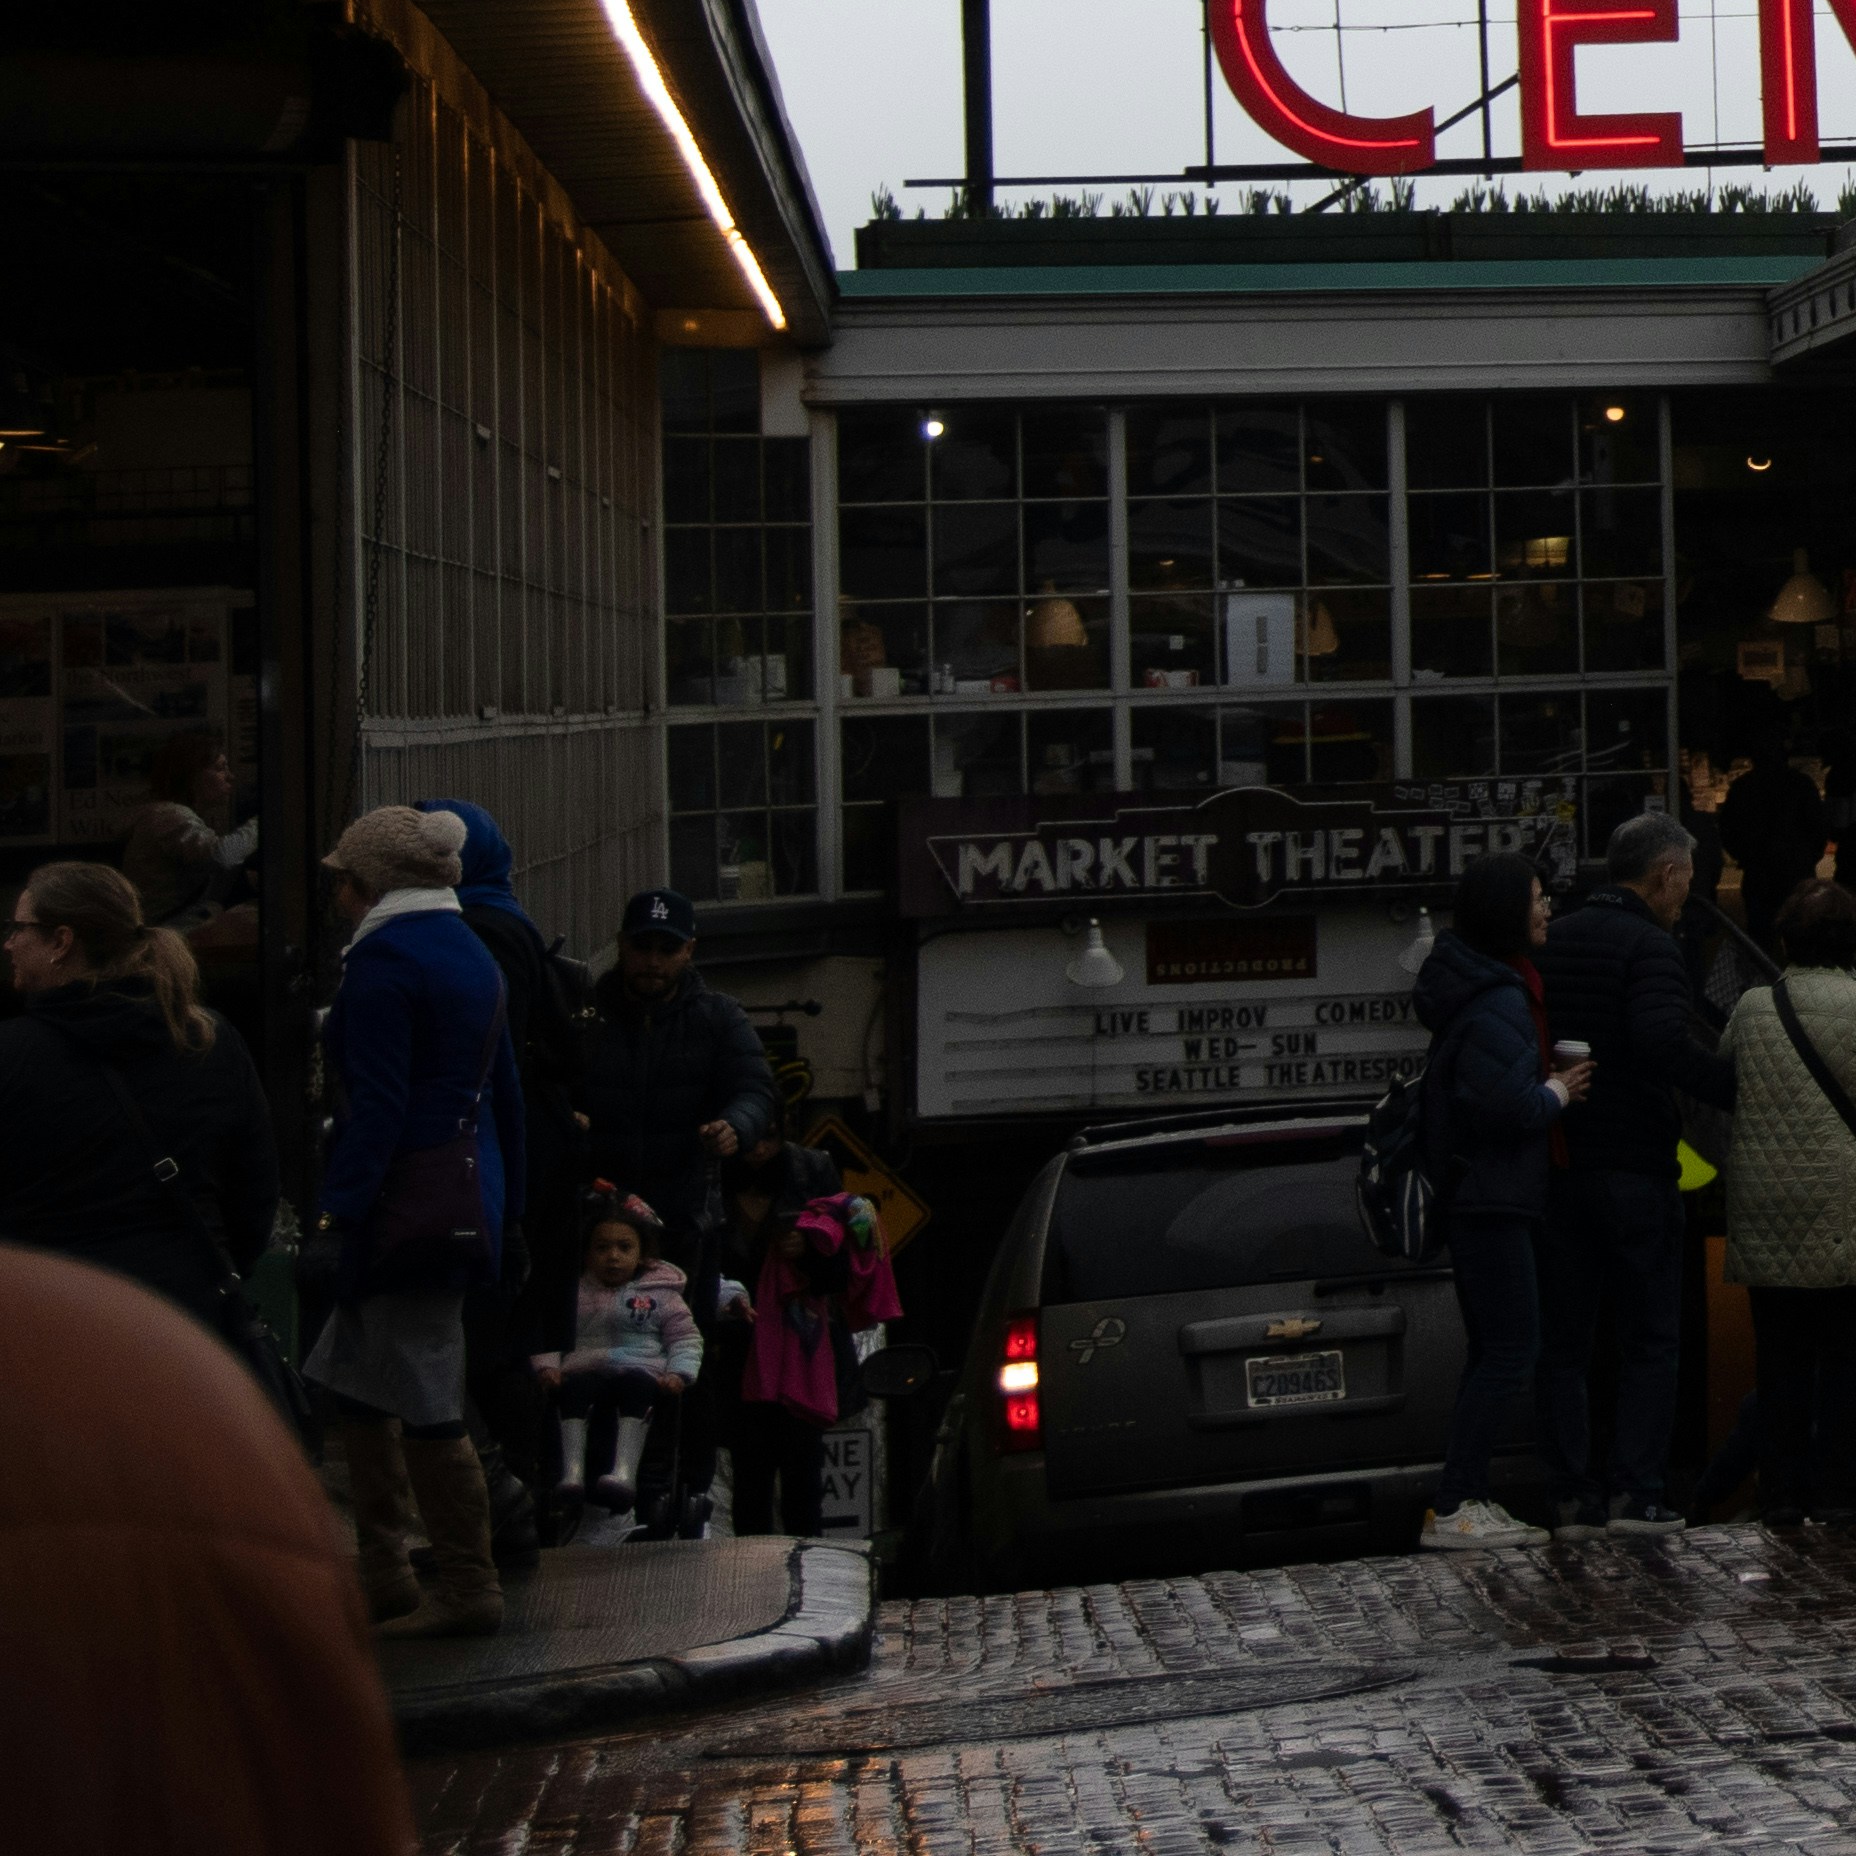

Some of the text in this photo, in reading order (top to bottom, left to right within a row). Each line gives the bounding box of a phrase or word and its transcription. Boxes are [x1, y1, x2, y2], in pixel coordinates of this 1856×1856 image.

[0, 731, 43, 745] arket
[957, 834, 1218, 896] MARKET
[650, 896, 670, 920] LA
[1156, 958, 1308, 976] PRODUCTIONS
[1094, 998, 1412, 1034] LIVE IMPROV COMEDY
[1272, 1033, 1317, 1056] SUN
[1136, 1066, 1240, 1091] SEATTLE
[823, 1440, 860, 1467] NE
[823, 1473, 862, 1500] AY
